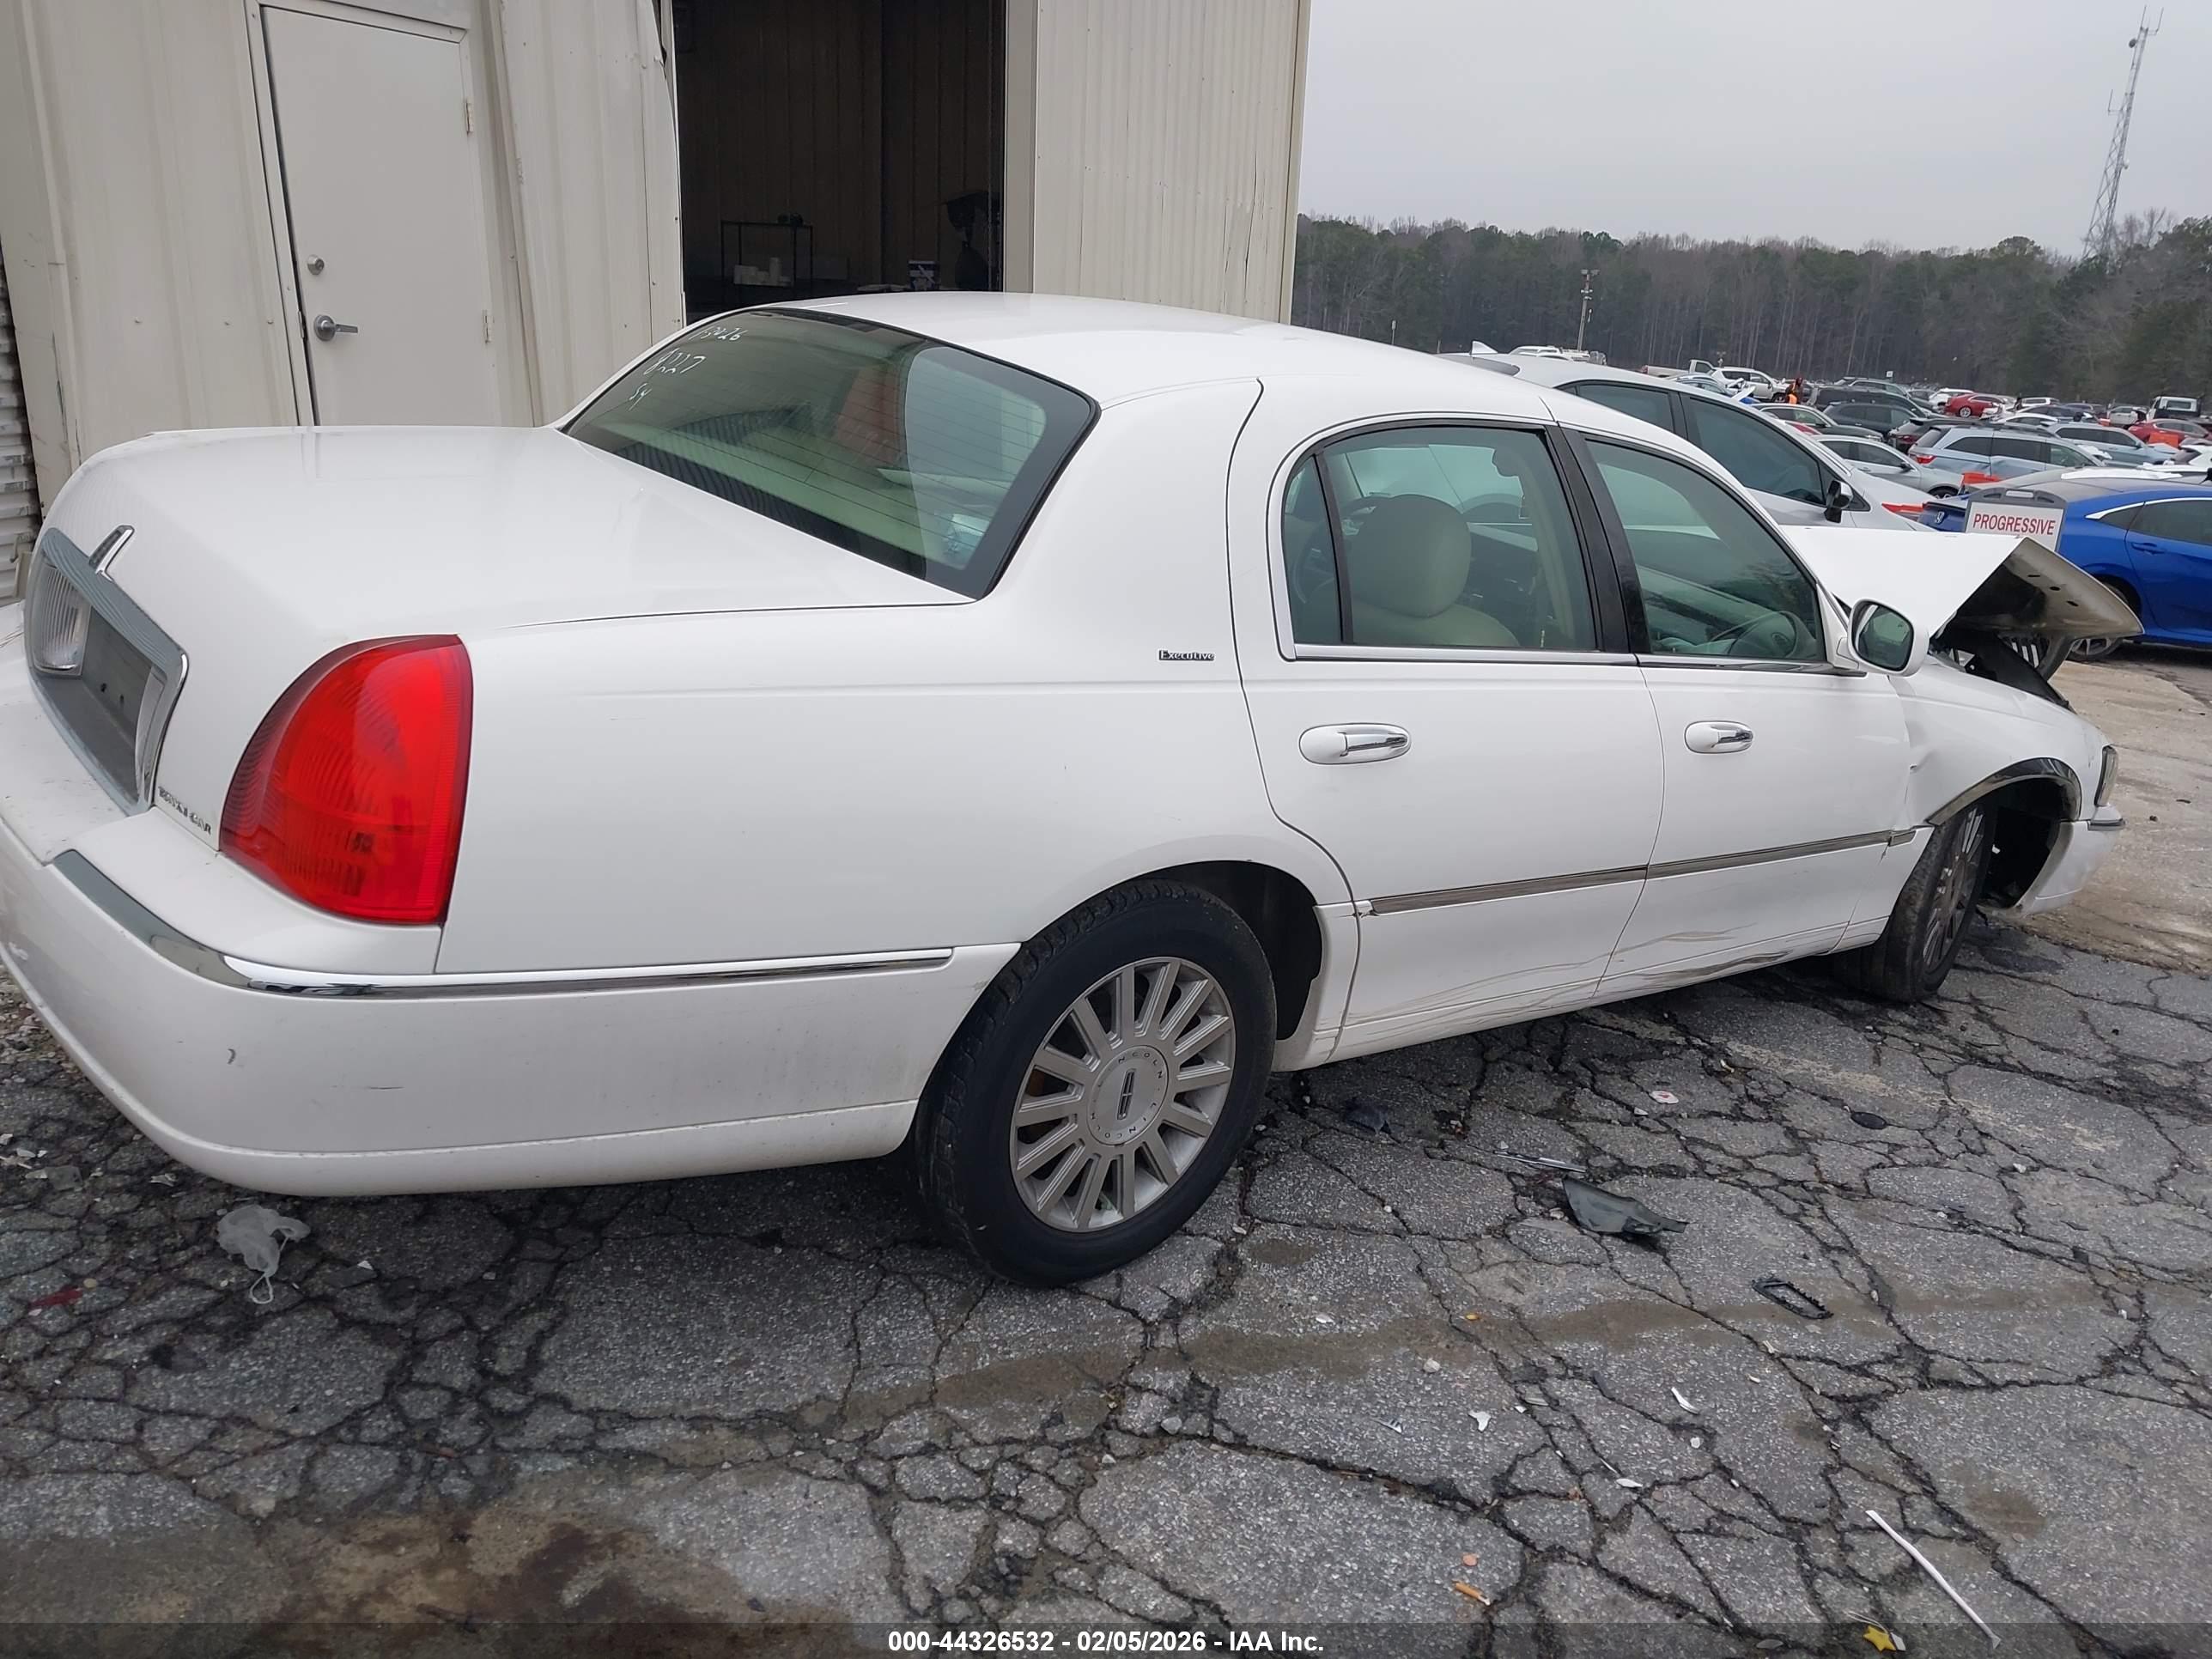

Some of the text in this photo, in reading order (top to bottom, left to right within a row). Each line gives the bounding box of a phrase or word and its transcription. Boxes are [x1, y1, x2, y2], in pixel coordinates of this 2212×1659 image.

[1972, 513, 2056, 536] PROGRESSIVE
[1158, 649, 1215, 661] Executive
[1097, 1052, 1163, 1087] LNCOLN
